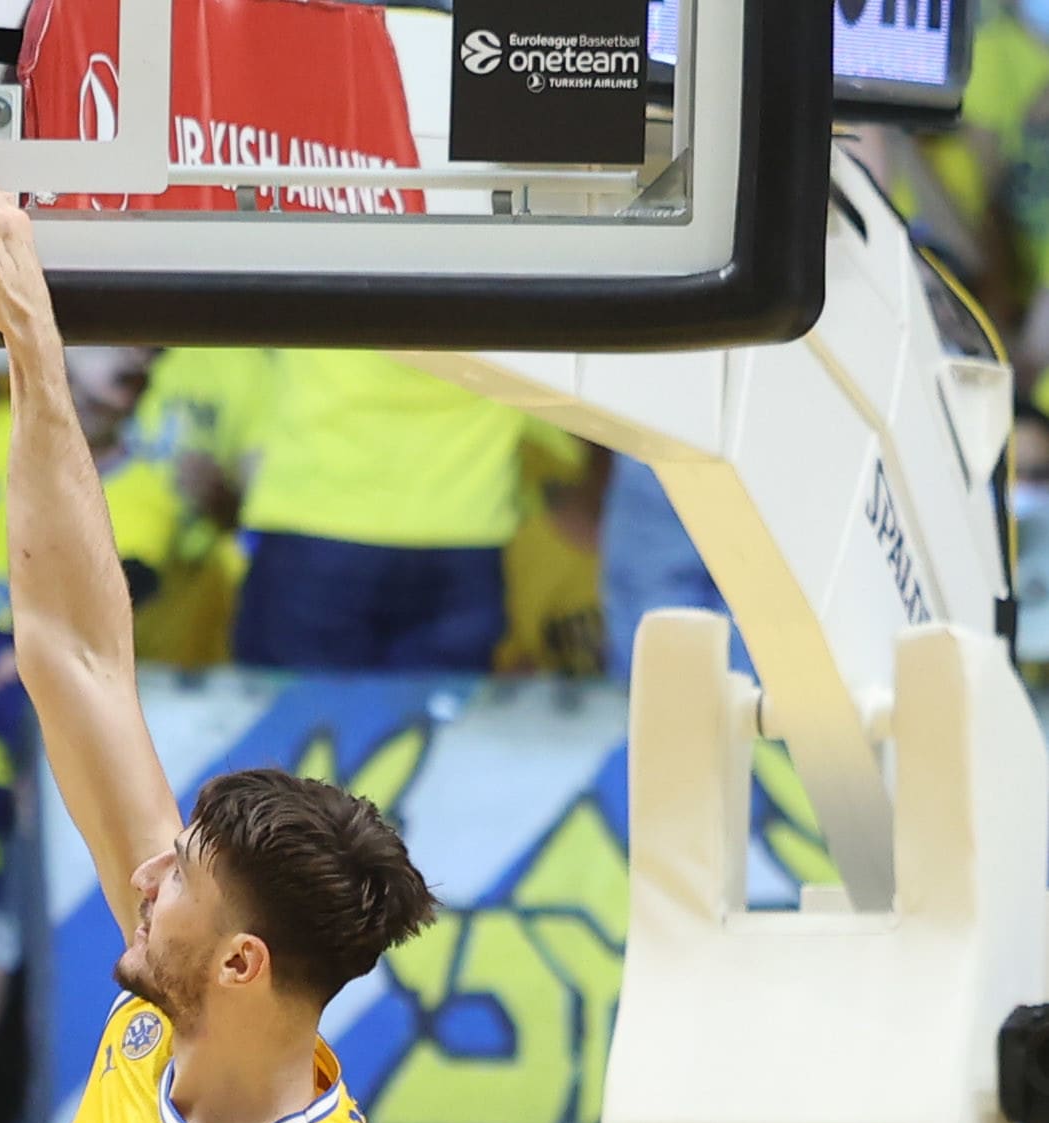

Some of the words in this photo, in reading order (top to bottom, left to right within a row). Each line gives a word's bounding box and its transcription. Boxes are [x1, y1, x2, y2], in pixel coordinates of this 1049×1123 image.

[509, 33, 577, 49] Euroleague
[579, 35, 640, 47] Basketball
[508, 48, 639, 73] oneteam
[549, 78, 592, 89] TURKISH
[594, 78, 638, 89] AIRLINES
[174, 115, 280, 197] RKISH
